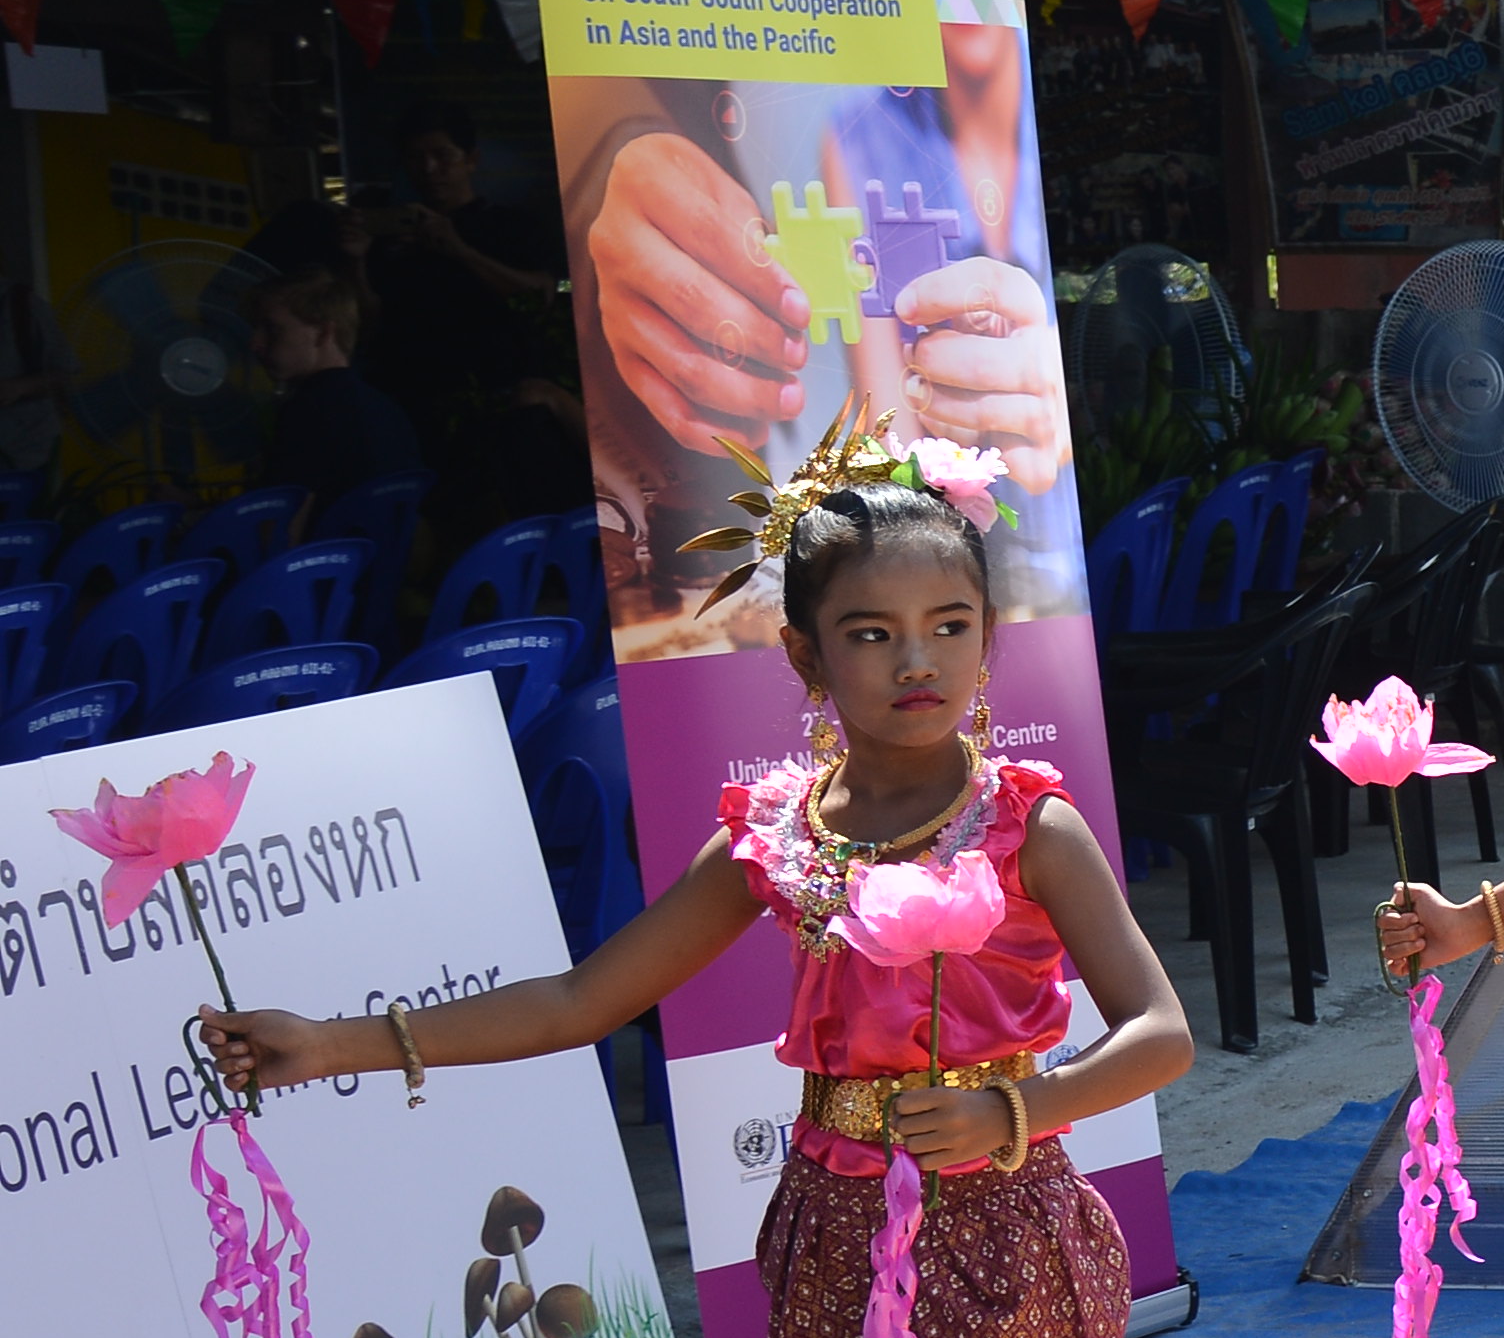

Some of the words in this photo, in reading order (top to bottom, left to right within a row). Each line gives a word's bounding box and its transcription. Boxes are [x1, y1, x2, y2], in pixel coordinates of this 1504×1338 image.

[586, 17, 611, 44] in
[619, 19, 671, 47] Asia
[677, 22, 717, 49] and
[722, 23, 758, 51] the
[763, 27, 836, 55] Pacific
[991, 722, 1057, 749] Centre
